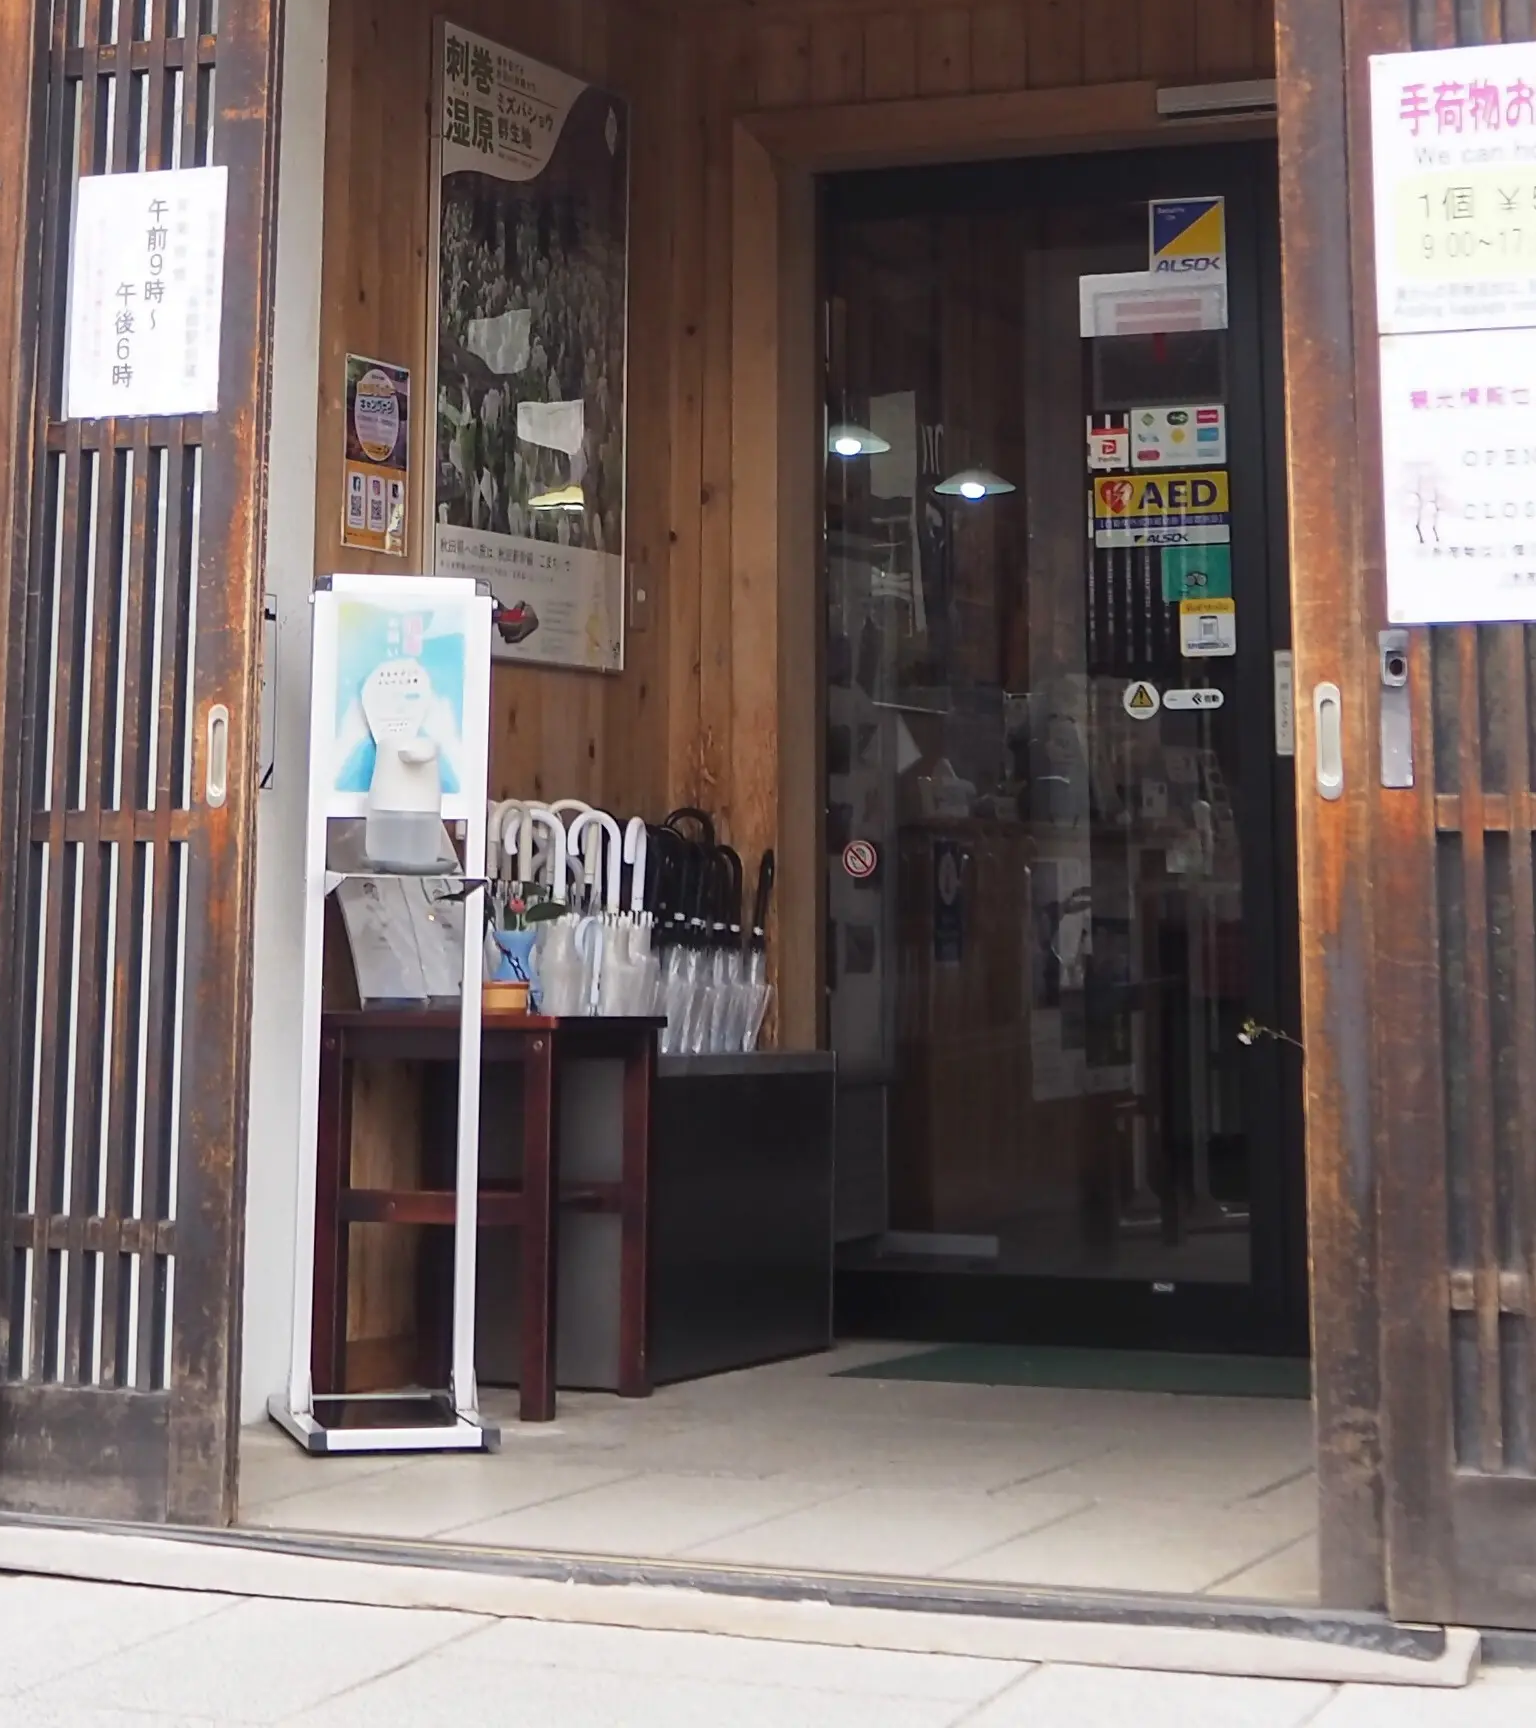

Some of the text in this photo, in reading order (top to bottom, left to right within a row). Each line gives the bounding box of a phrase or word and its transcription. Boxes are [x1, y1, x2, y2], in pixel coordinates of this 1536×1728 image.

[446, 35, 494, 95] 刺巻
[444, 95, 494, 154] 湿原
[1154, 256, 1221, 273] ALSOK
[112, 282, 137, 389] 午後6時
[1138, 479, 1218, 510] AED
